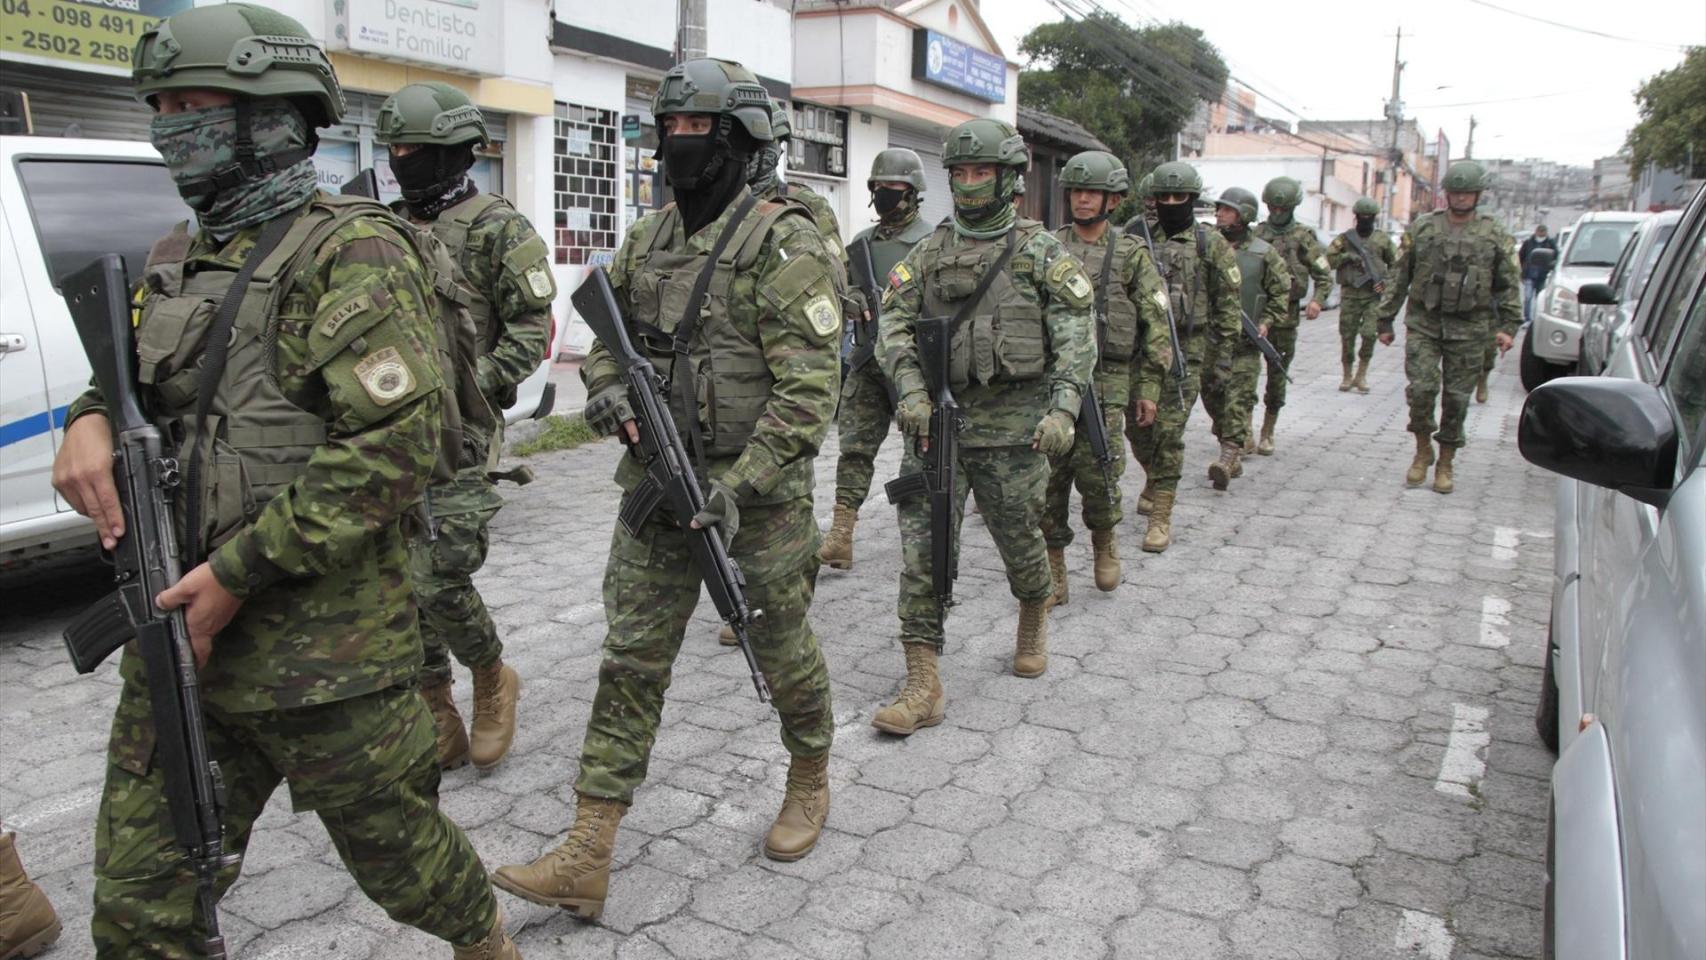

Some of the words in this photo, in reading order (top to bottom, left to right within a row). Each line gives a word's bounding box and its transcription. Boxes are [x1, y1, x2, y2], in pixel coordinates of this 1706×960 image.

[52, 5, 93, 29] 098
[98, 14, 135, 37] 491
[384, 0, 477, 38] Dentista
[22, 30, 82, 57] 2502
[89, 41, 134, 63] 258
[396, 28, 472, 62] Familiar
[317, 168, 345, 186] iliar
[327, 301, 362, 331] SELVA
